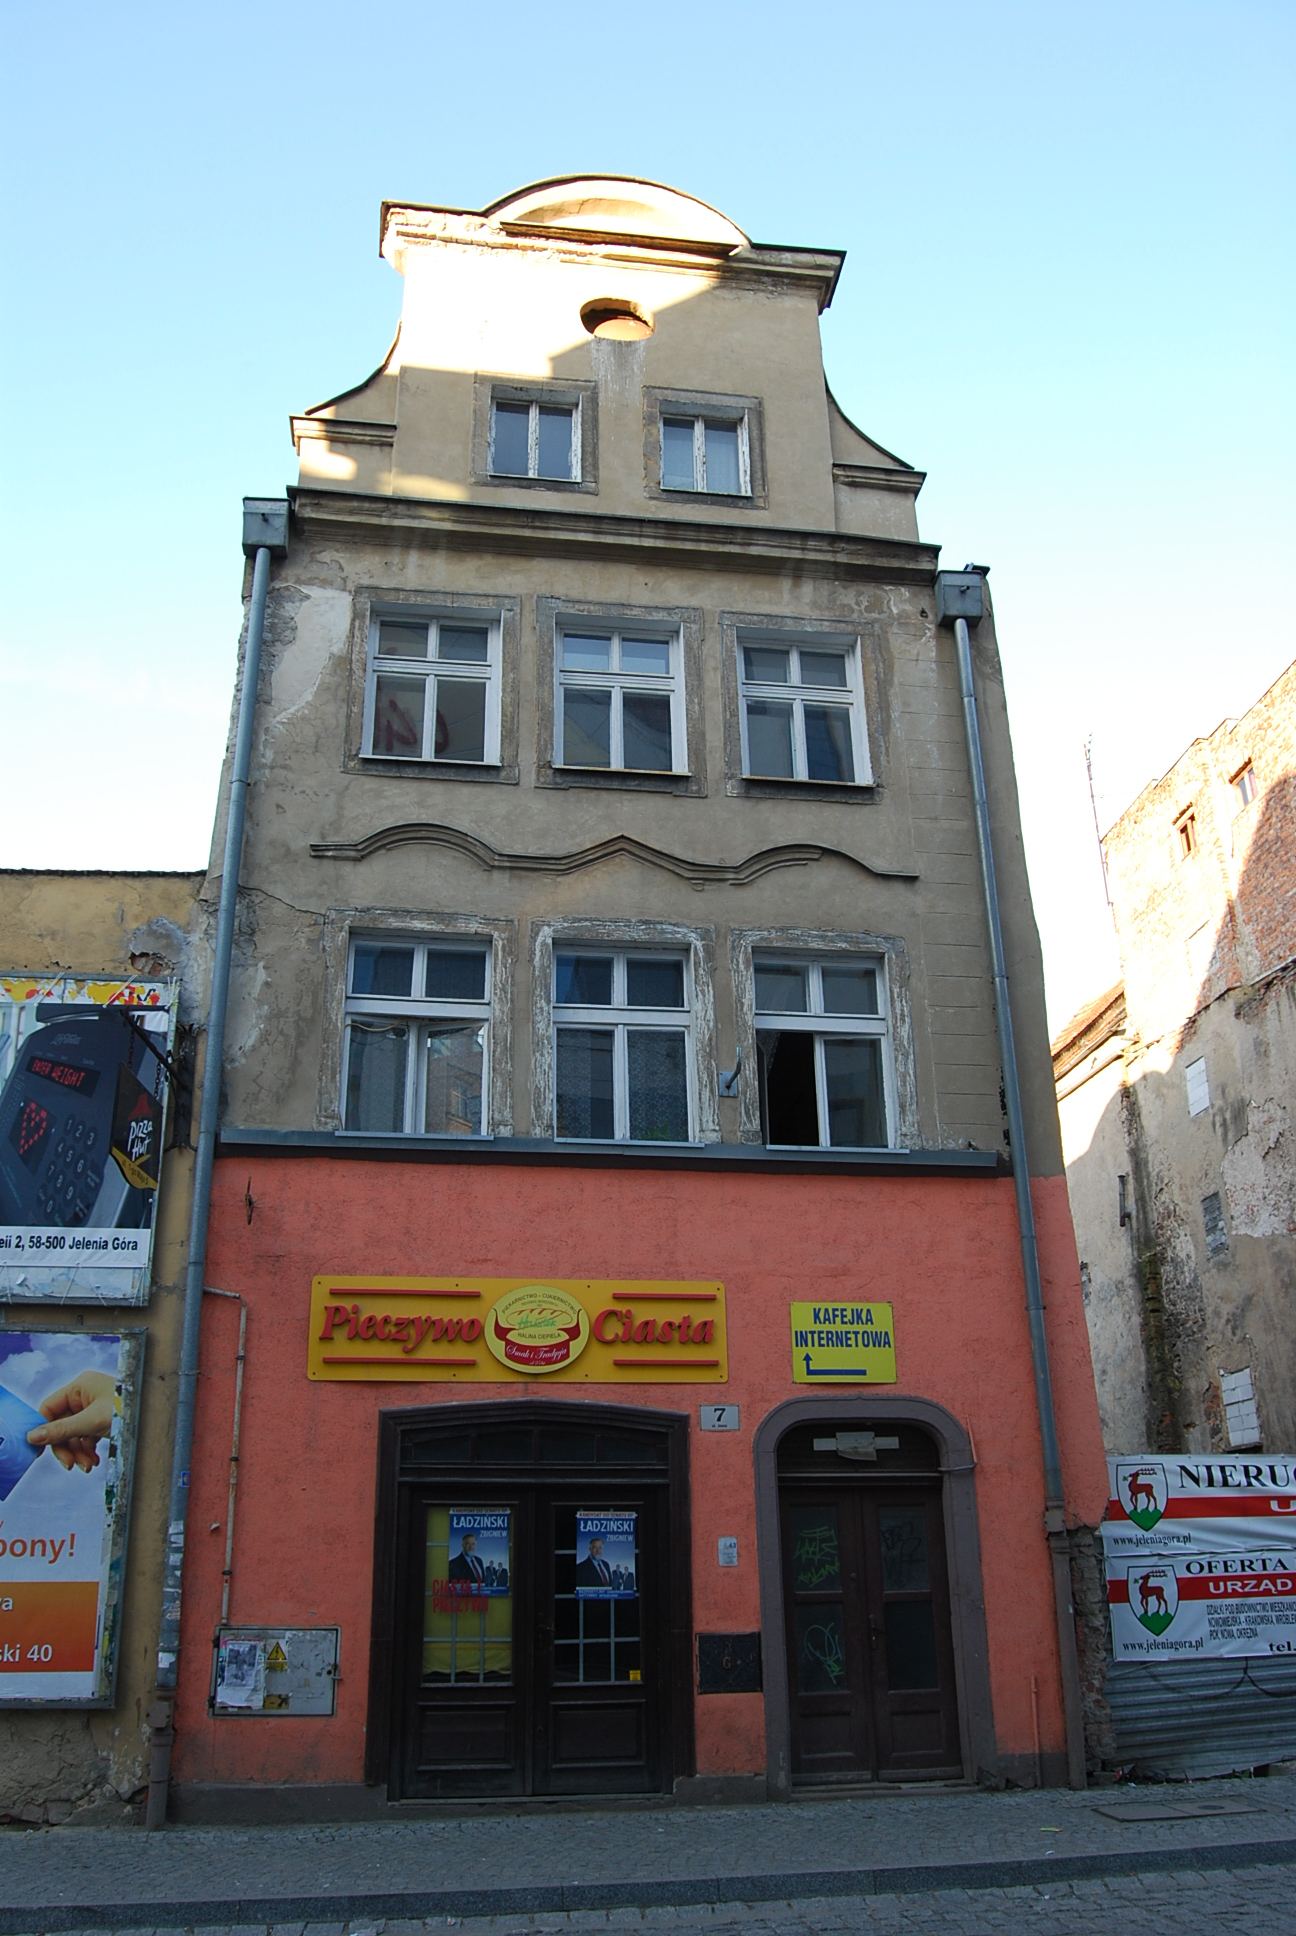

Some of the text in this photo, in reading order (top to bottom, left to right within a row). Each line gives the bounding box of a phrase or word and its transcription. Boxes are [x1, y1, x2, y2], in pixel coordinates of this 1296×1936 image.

[51, 1064, 86, 1088] WEIGHT
[66, 1119, 95, 1145] 1 2 3
[131, 1136, 152, 1161] Hut
[66, 1150, 73, 1162] 5
[77, 1159, 84, 1172] 6
[48, 1165, 55, 1176] 7
[66, 1186, 74, 1200] 9
[15, 1235, 25, 1251] 2,
[28, 1235, 66, 1250] 58-500
[69, 1236, 108, 1251] Jelenia
[112, 1236, 138, 1251] Góra
[812, 1307, 874, 1326] KAFEJKA
[318, 1303, 483, 1353] Pieczywo
[592, 1308, 717, 1345] Ciasta
[794, 1330, 892, 1349] INTERNETOWA
[506, 1345, 530, 1358] Smak
[713, 1407, 726, 1422] 7
[1177, 1464, 1296, 1489] NIERU
[453, 1514, 508, 1528] ŁADZIŃSKI
[580, 1518, 633, 1532] ŁADZIŃSKI
[479, 1530, 508, 1538] ZBIGNIEW
[606, 1534, 633, 1542] ZBIGNIEW
[1112, 1533, 1192, 1547] www.jeleniagora.pl
[1185, 1558, 1289, 1575] OFERTA
[1209, 1579, 1293, 1595] URZĄD
[1235, 1602, 1269, 1614] BUDOWNICTWO
[26, 1643, 53, 1662] 40
[1123, 1638, 1204, 1653] www.jeleniagora.pl
[1269, 1640, 1296, 1652] tel.
